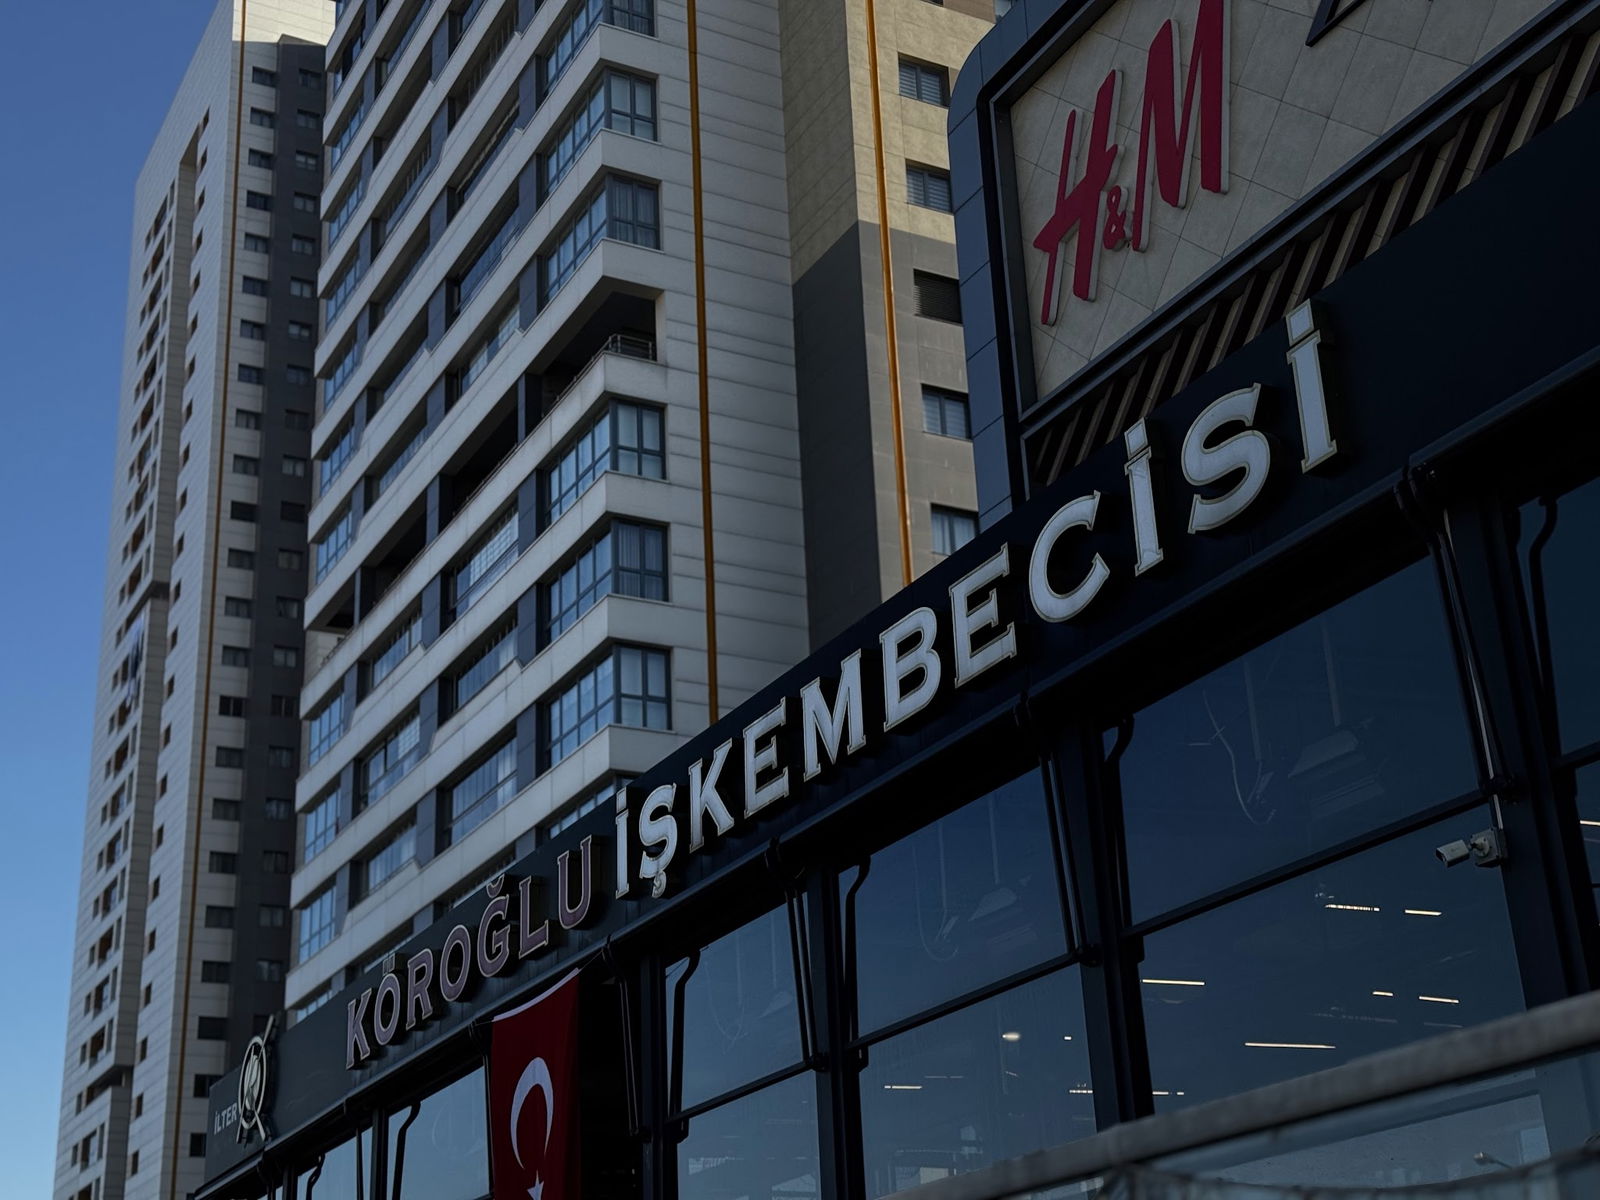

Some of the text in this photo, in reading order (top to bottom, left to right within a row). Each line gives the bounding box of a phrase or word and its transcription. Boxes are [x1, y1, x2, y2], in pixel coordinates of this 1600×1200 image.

[1033, 0, 1229, 326] H&M
[346, 297, 1338, 1070] KÖROĞLU İŞKEMBECİSİ
